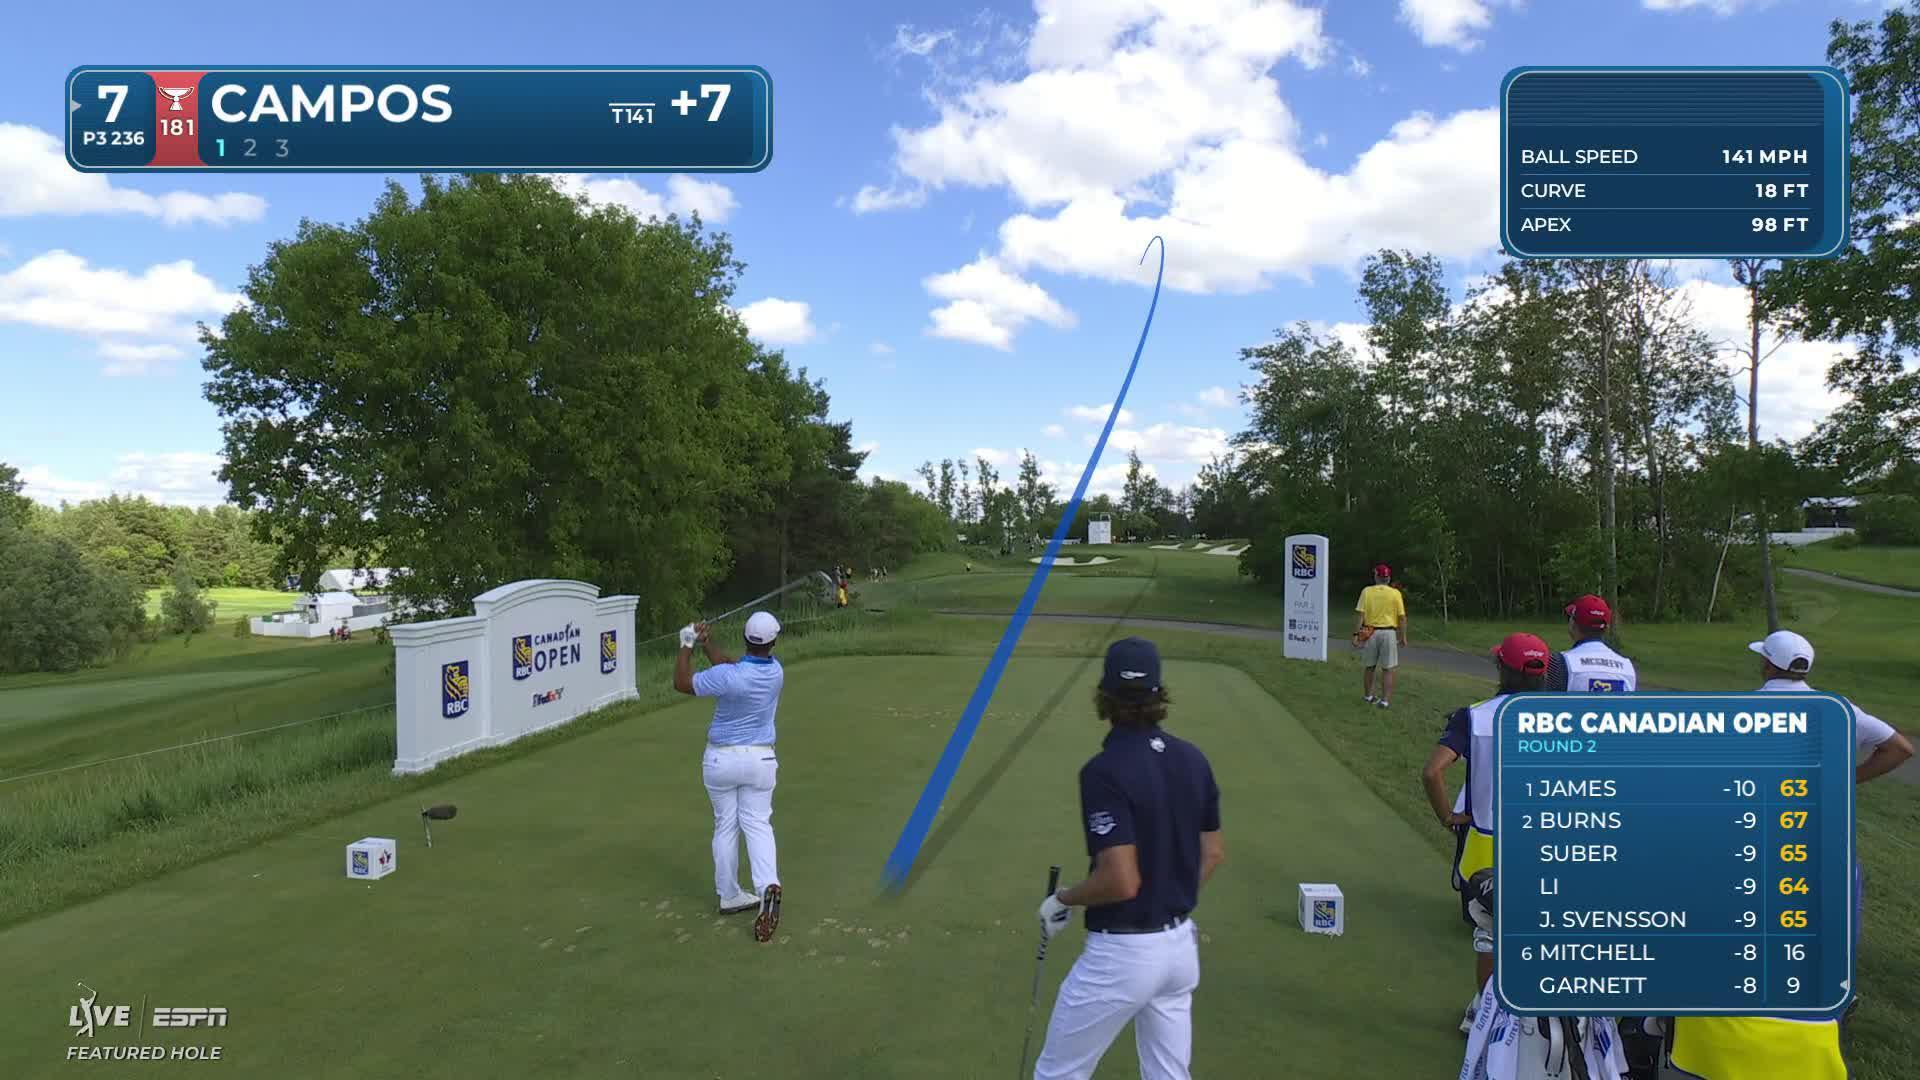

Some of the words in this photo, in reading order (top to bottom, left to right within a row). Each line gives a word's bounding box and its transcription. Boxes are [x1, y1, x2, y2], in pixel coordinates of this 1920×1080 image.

[1294, 568, 1314, 577] RBC
[1300, 584, 1309, 598] 7
[535, 625, 580, 645] CANADIAN
[535, 643, 580, 672] OPEN
[516, 666, 531, 677] RBC
[603, 661, 616, 671] RBC
[447, 700, 467, 715] RBC
[1316, 919, 1334, 927] RBC
